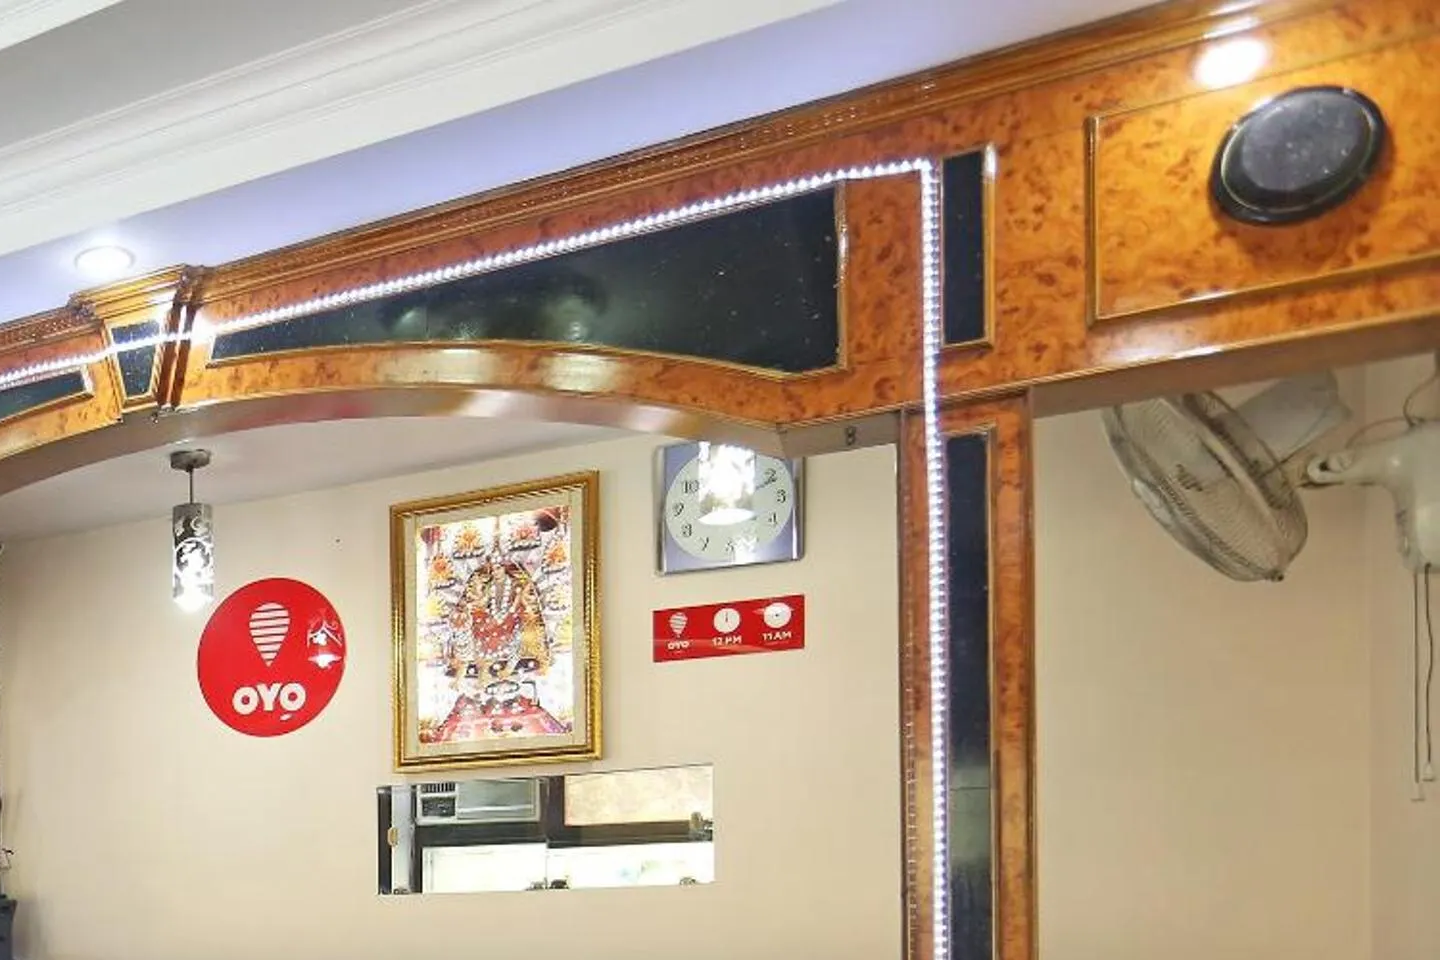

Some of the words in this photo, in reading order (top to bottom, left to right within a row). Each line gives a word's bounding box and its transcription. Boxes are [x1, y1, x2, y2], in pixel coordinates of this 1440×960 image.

[683, 480, 700, 494] 10
[777, 489, 786, 504] 3
[667, 640, 690, 650] OYO
[712, 637, 723, 646] 12
[725, 635, 742, 645] PM
[232, 682, 307, 715] OYO
